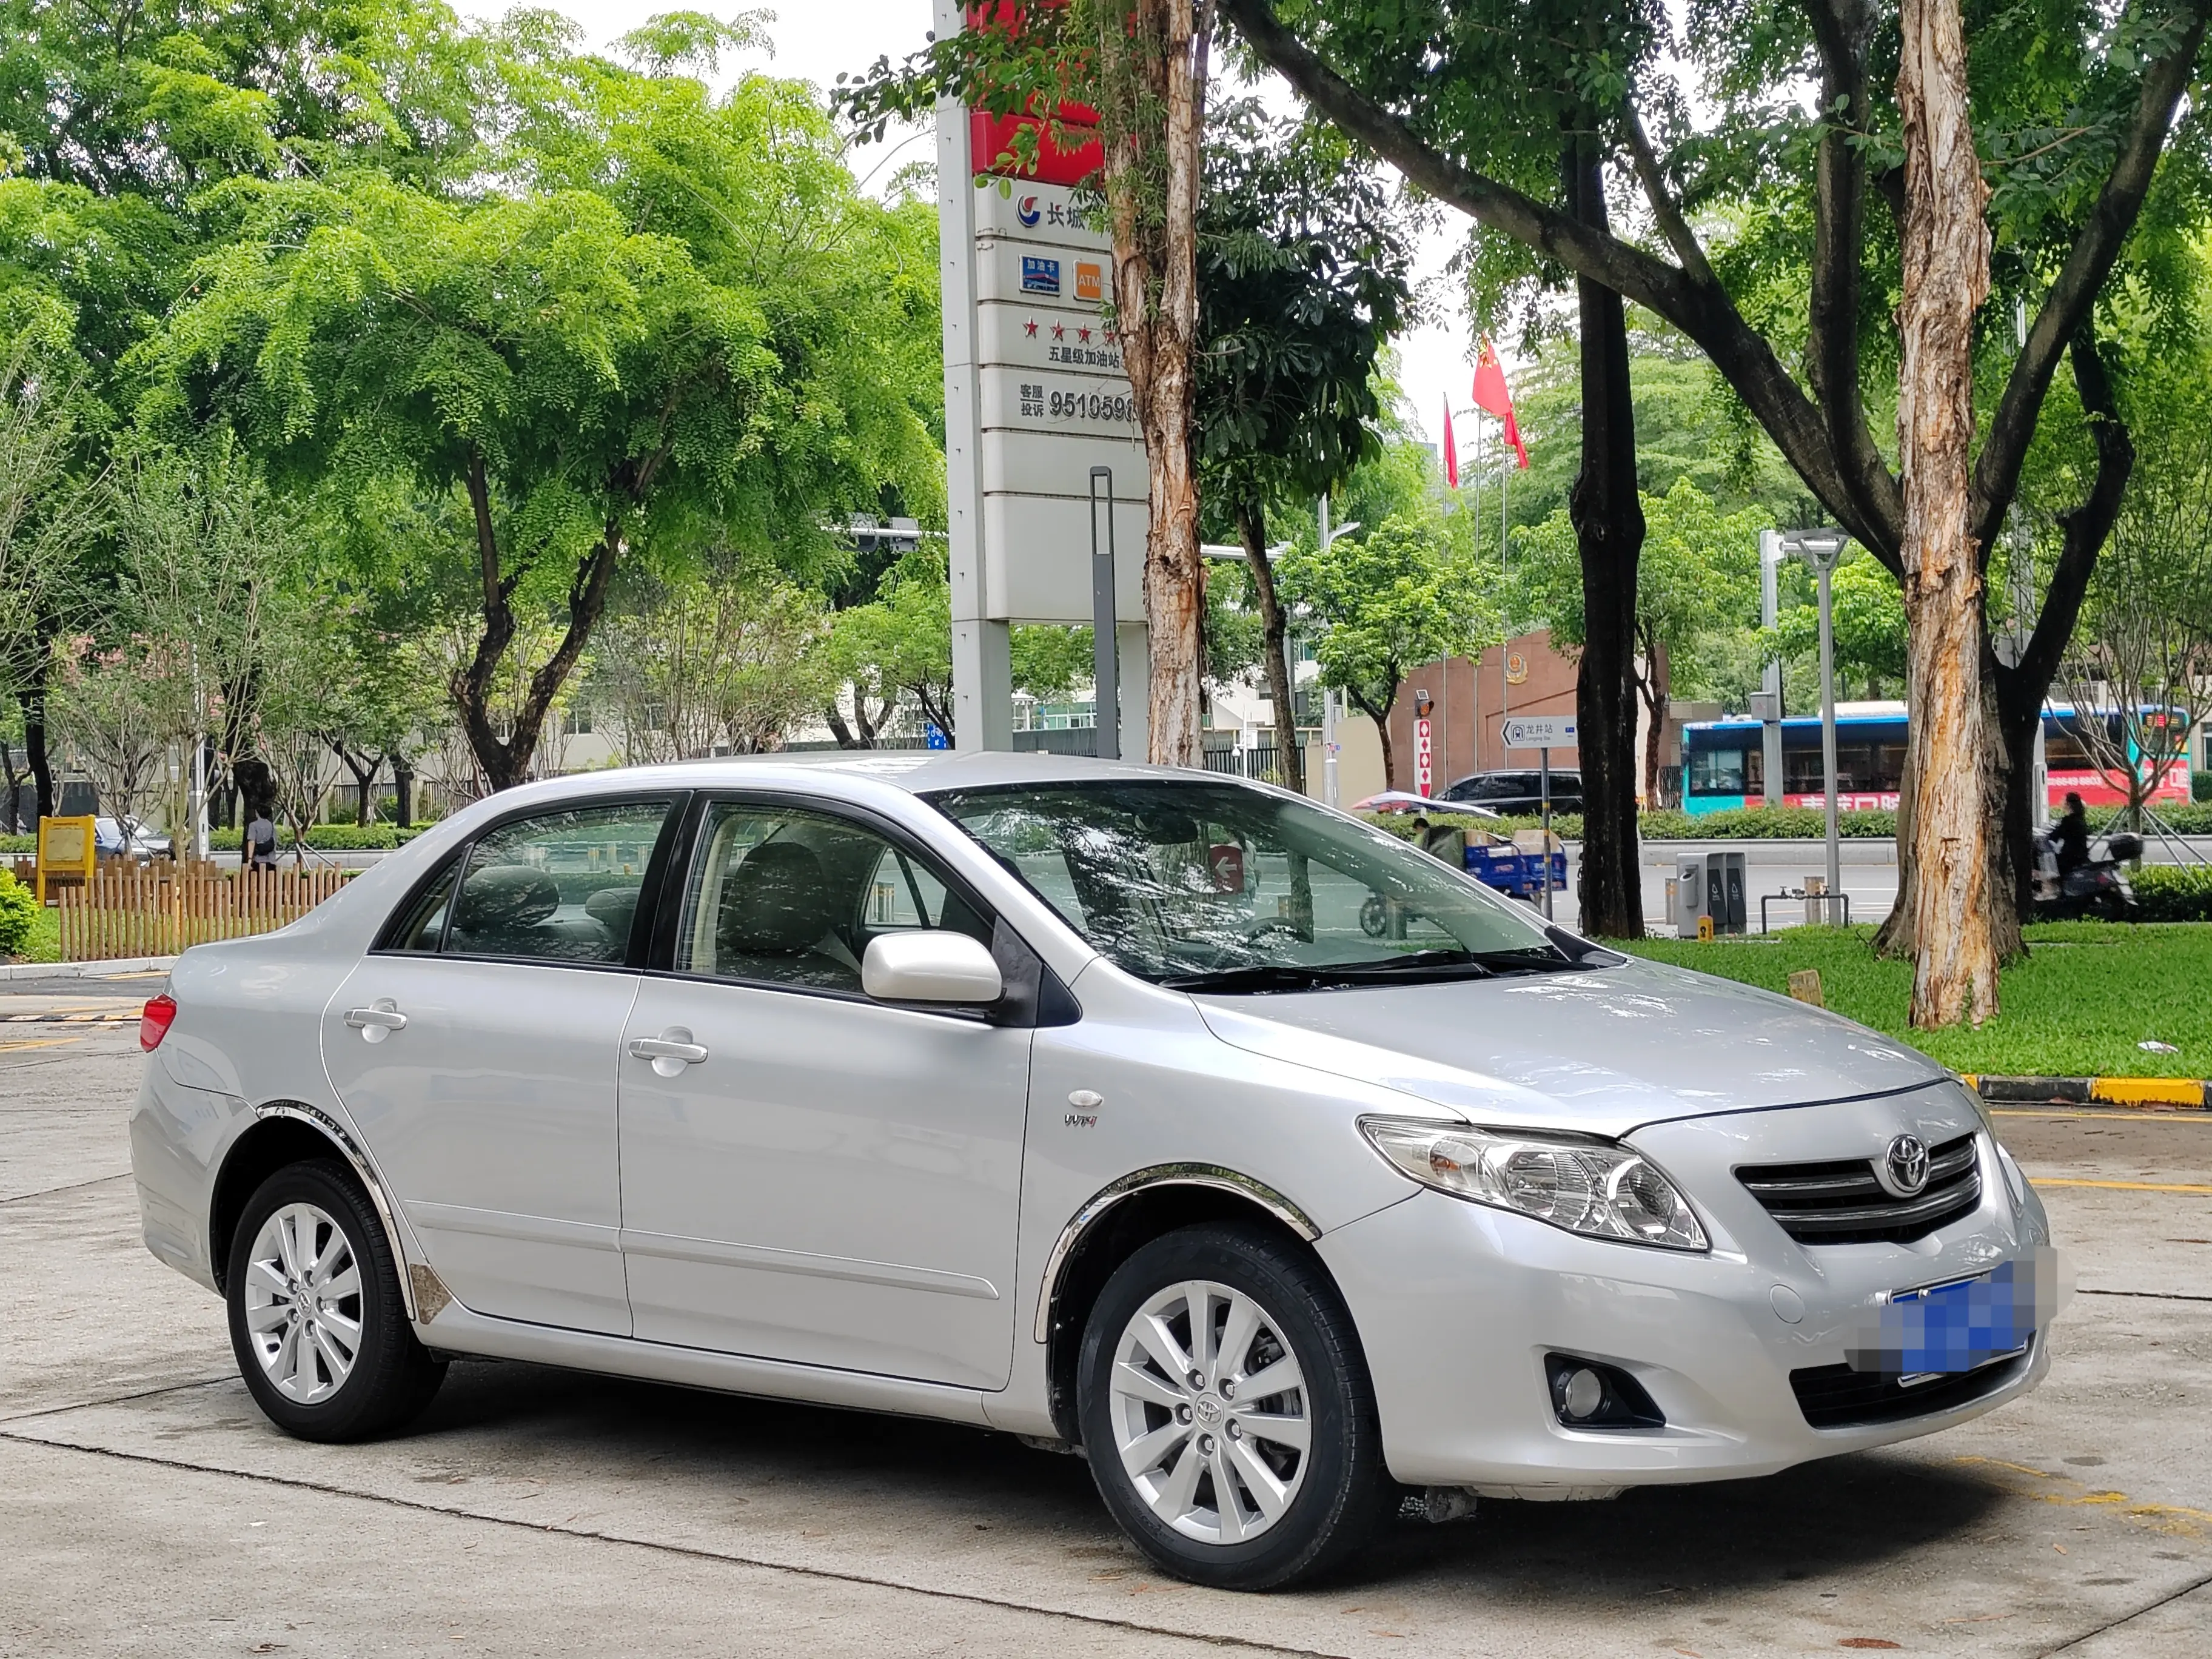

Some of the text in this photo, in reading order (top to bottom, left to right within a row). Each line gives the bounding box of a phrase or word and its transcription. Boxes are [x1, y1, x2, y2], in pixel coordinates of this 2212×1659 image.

[1047, 202, 1085, 230] 长城
[1027, 258, 1056, 272] 加油卡
[1079, 275, 1101, 288] ATM
[1048, 346, 1119, 369] 五星级加油站
[1020, 384, 1044, 399] 客服
[1021, 402, 1044, 418] 投诉
[1526, 724, 1553, 734] 龙井站
